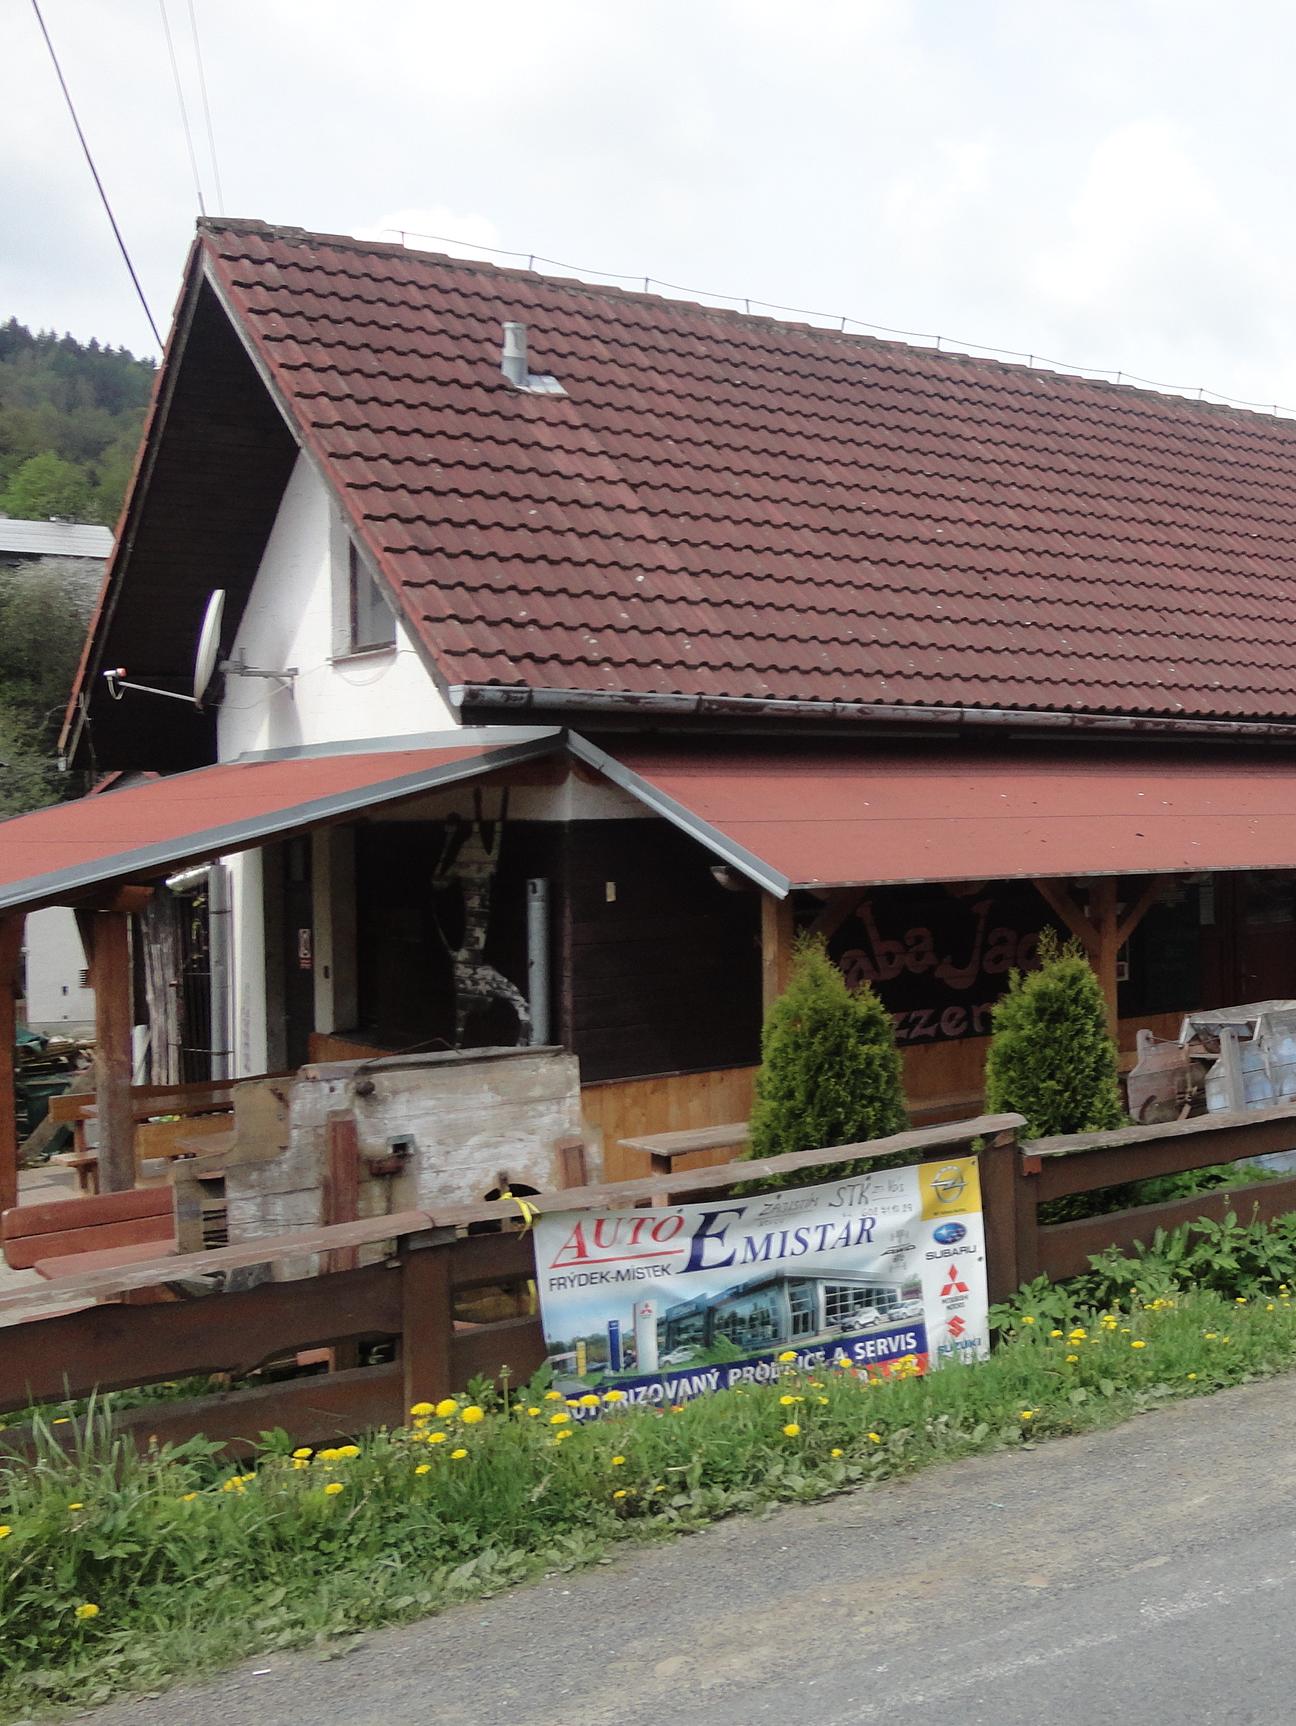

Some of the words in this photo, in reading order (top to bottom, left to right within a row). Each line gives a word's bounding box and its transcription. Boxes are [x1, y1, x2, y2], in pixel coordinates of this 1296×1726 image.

[839, 900, 939, 988] aba
[892, 1000, 995, 1039] zzer
[551, 1215, 685, 1266] AUTO
[676, 1206, 877, 1274] EMISTAR
[925, 1245, 977, 1261] SUBARU
[549, 1264, 672, 1292] FRÝDEK-MÍSTEK
[833, 1346, 846, 1363] A
[854, 1331, 917, 1360] SERVIS
[938, 1338, 981, 1354] SUZUKI
